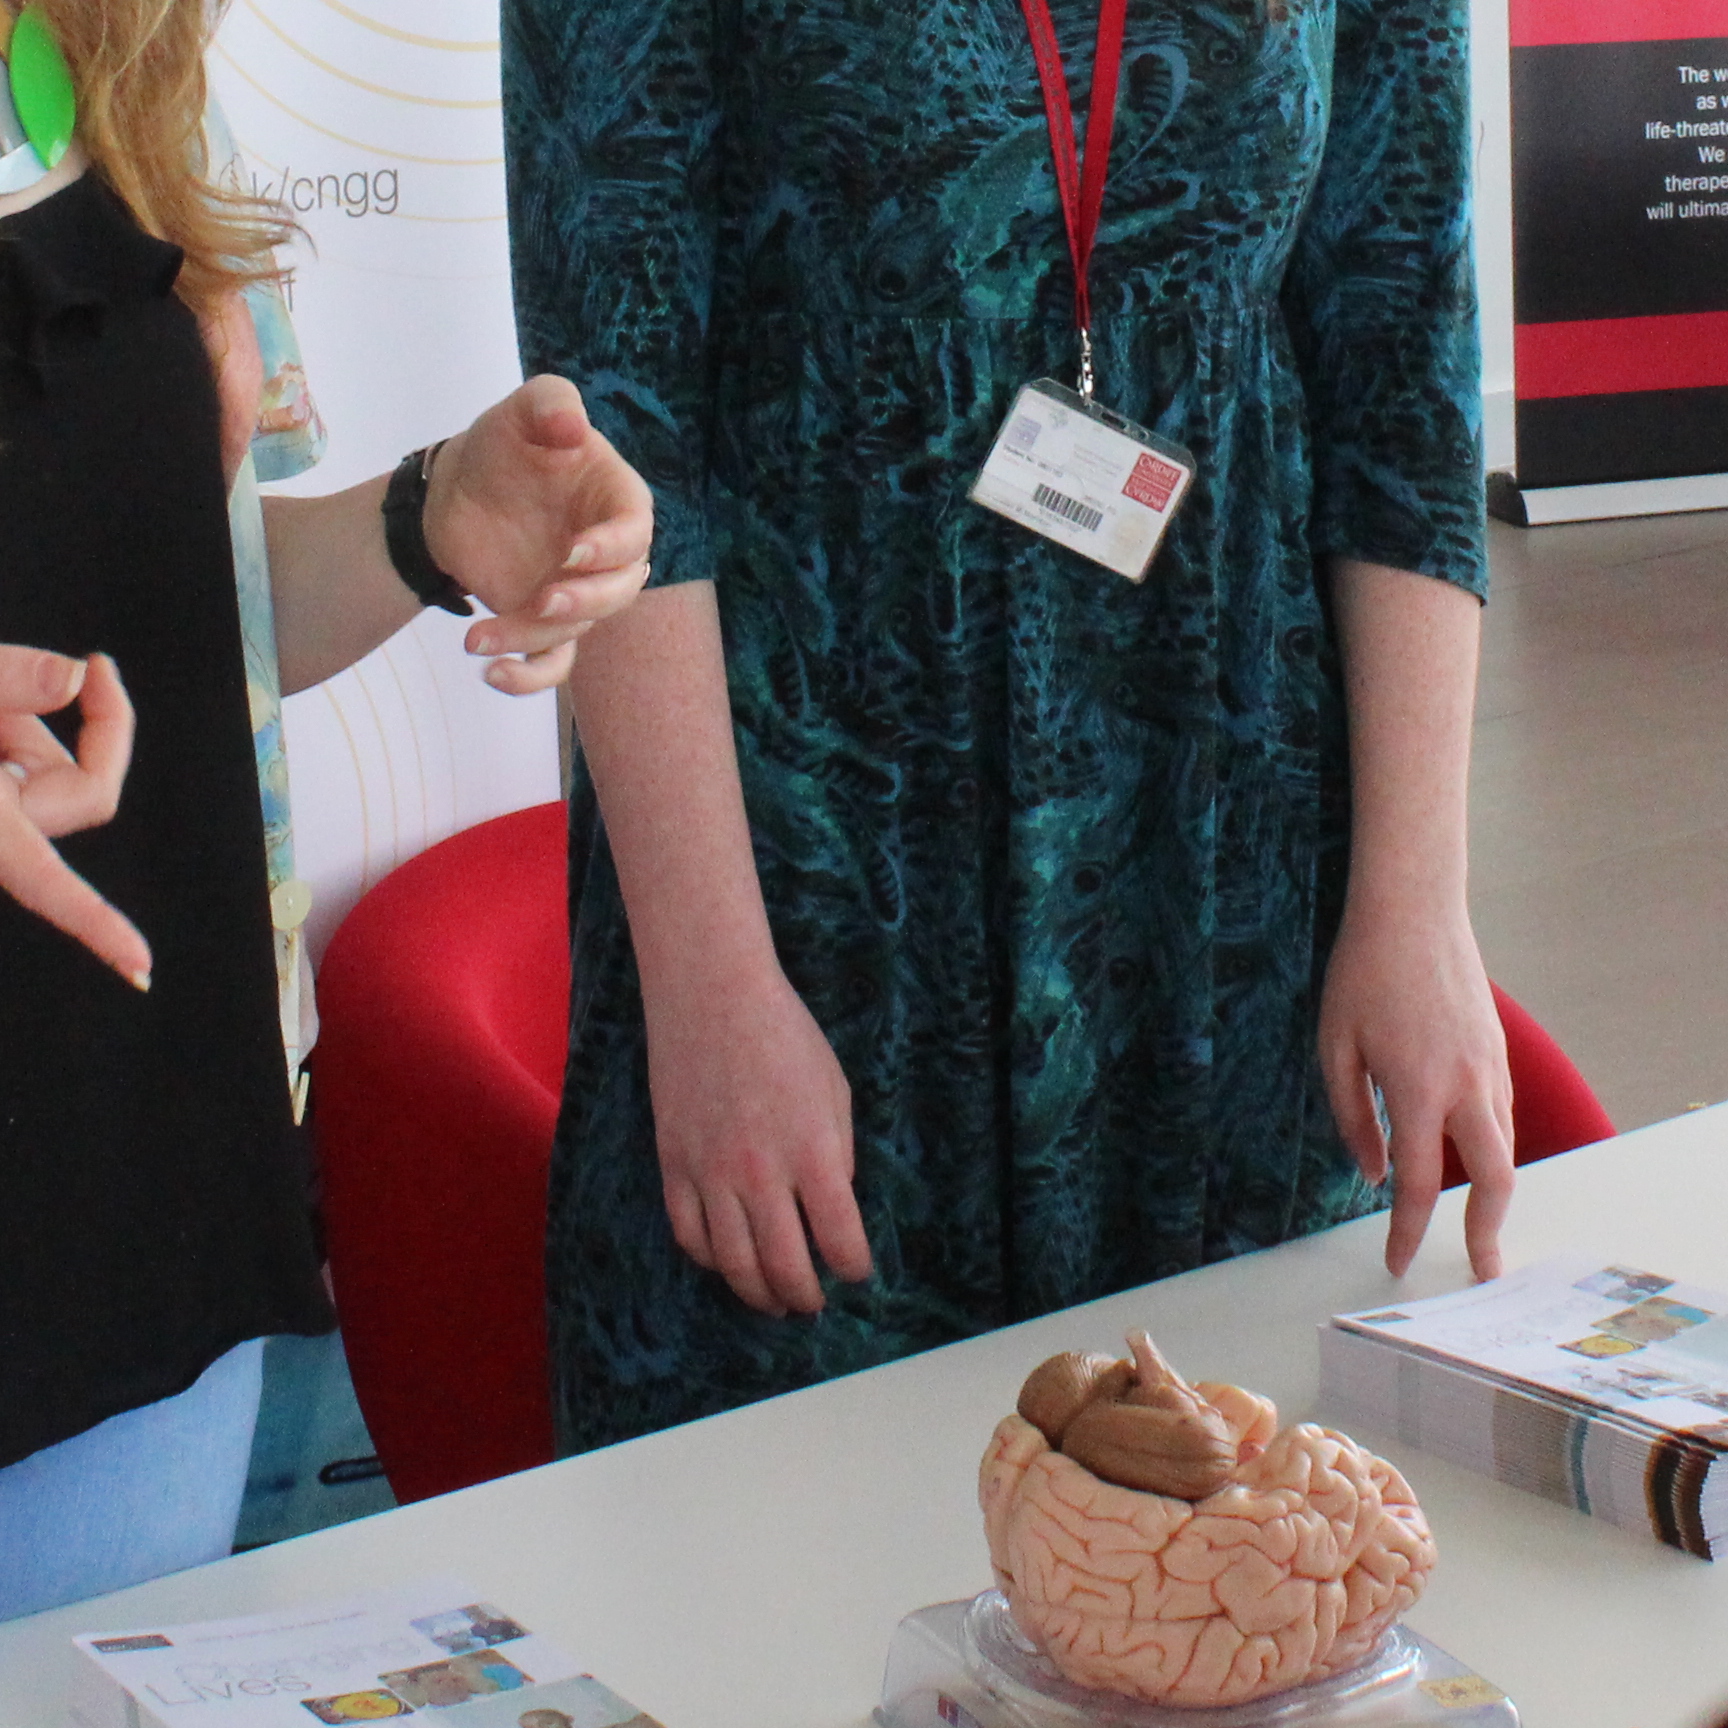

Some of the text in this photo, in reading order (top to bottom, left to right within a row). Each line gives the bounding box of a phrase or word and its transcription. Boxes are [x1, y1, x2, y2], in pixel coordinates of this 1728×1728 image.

[1679, 65, 1710, 84] The
[1696, 94, 1717, 111] as
[1698, 145, 1726, 164] We
[1646, 200, 1674, 220] will
